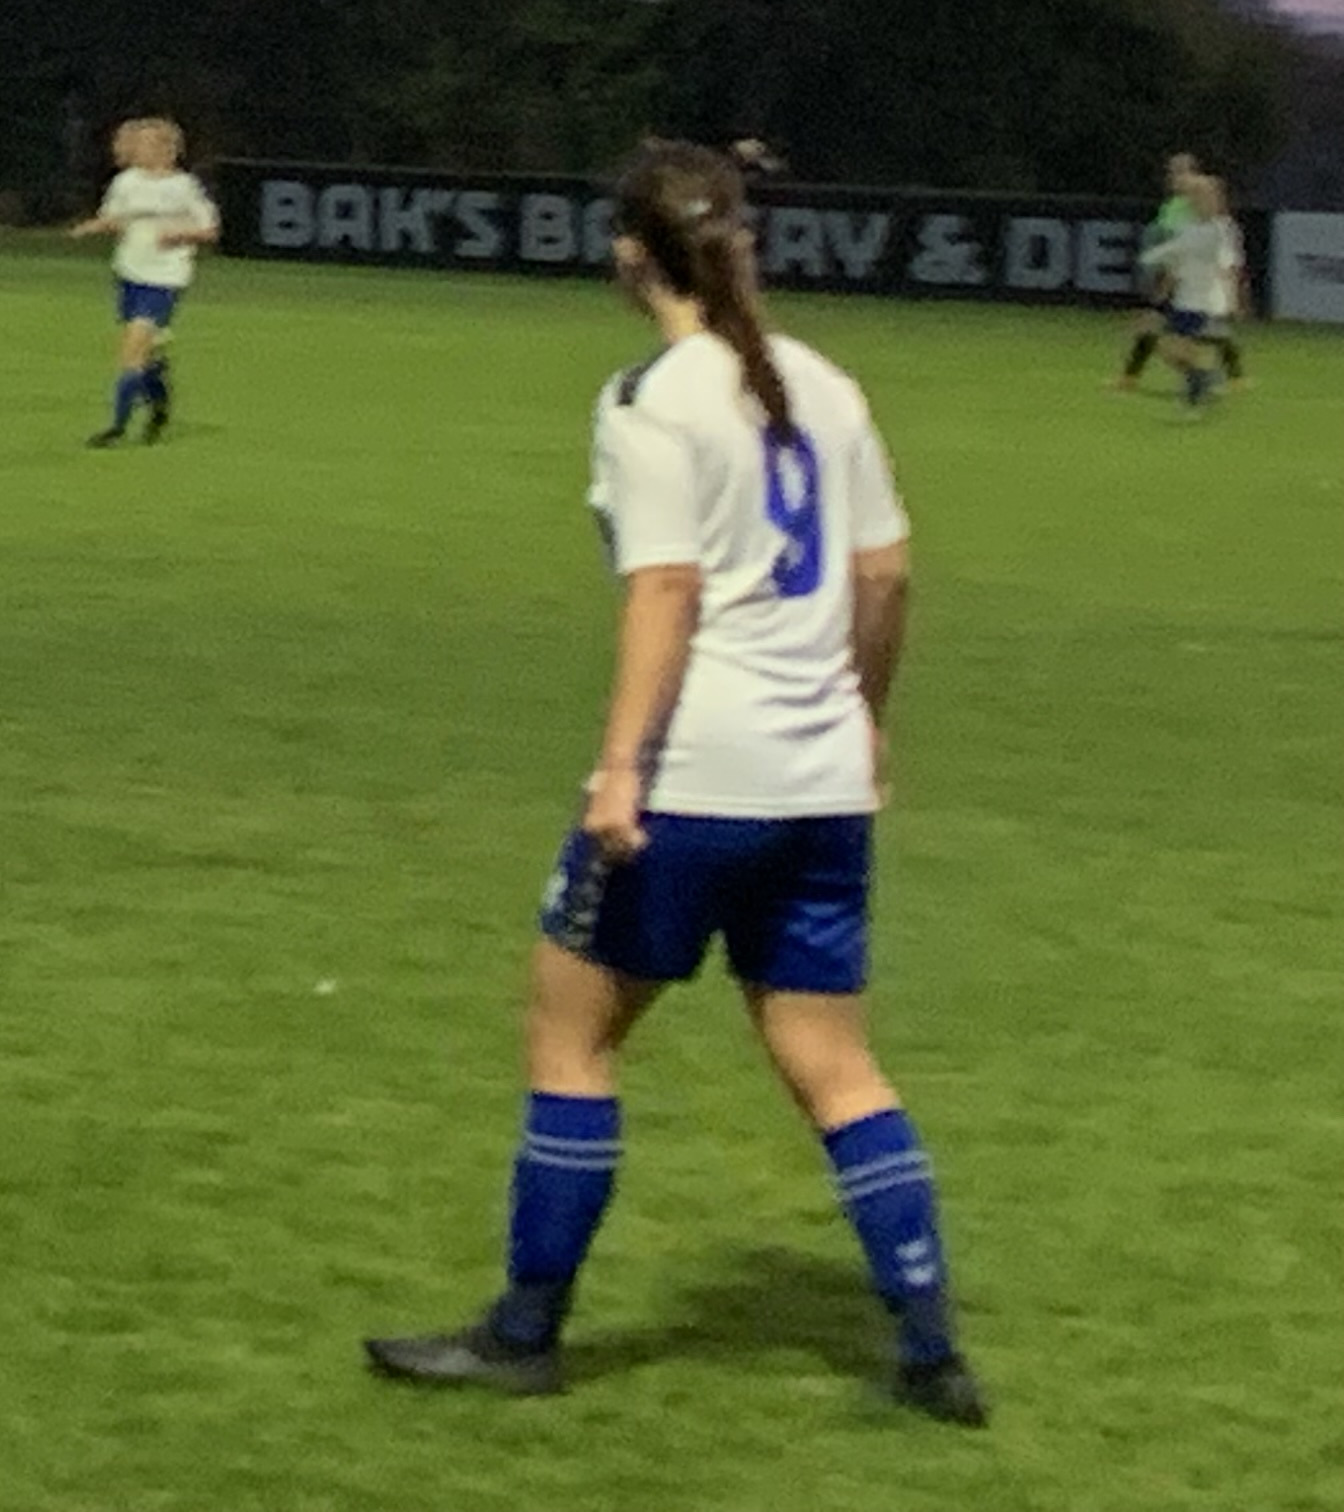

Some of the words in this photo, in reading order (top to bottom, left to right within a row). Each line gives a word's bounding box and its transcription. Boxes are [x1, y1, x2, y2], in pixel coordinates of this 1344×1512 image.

[260, 180, 501, 258] BAK'S
[519, 193, 889, 279] BARY
[912, 213, 986, 284] &
[1003, 216, 1162, 292] DE
[764, 422, 823, 598] 9
